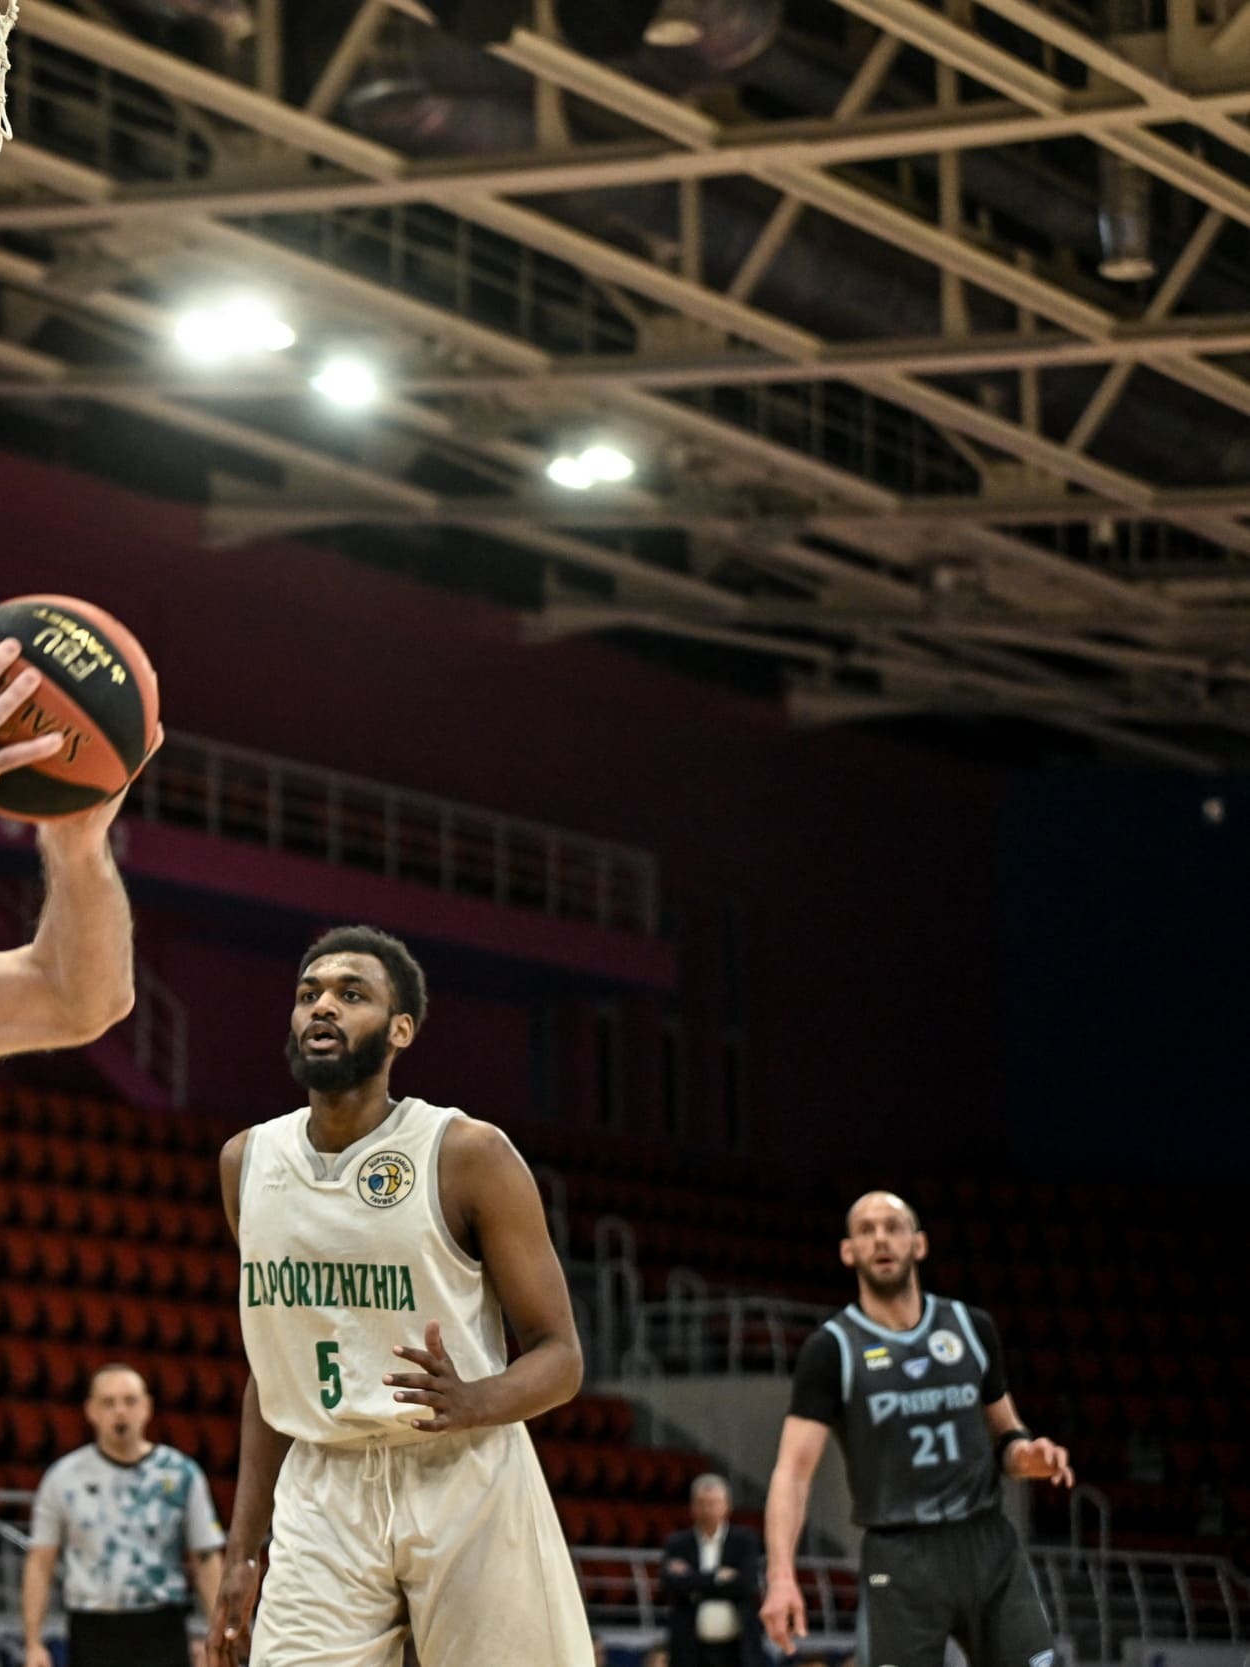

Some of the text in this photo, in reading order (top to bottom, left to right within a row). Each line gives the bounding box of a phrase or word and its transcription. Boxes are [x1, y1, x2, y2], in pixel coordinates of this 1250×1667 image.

[315, 1340, 343, 1410] 5
[866, 1383, 980, 1426] DNIPRO
[908, 1420, 961, 1469] 21
